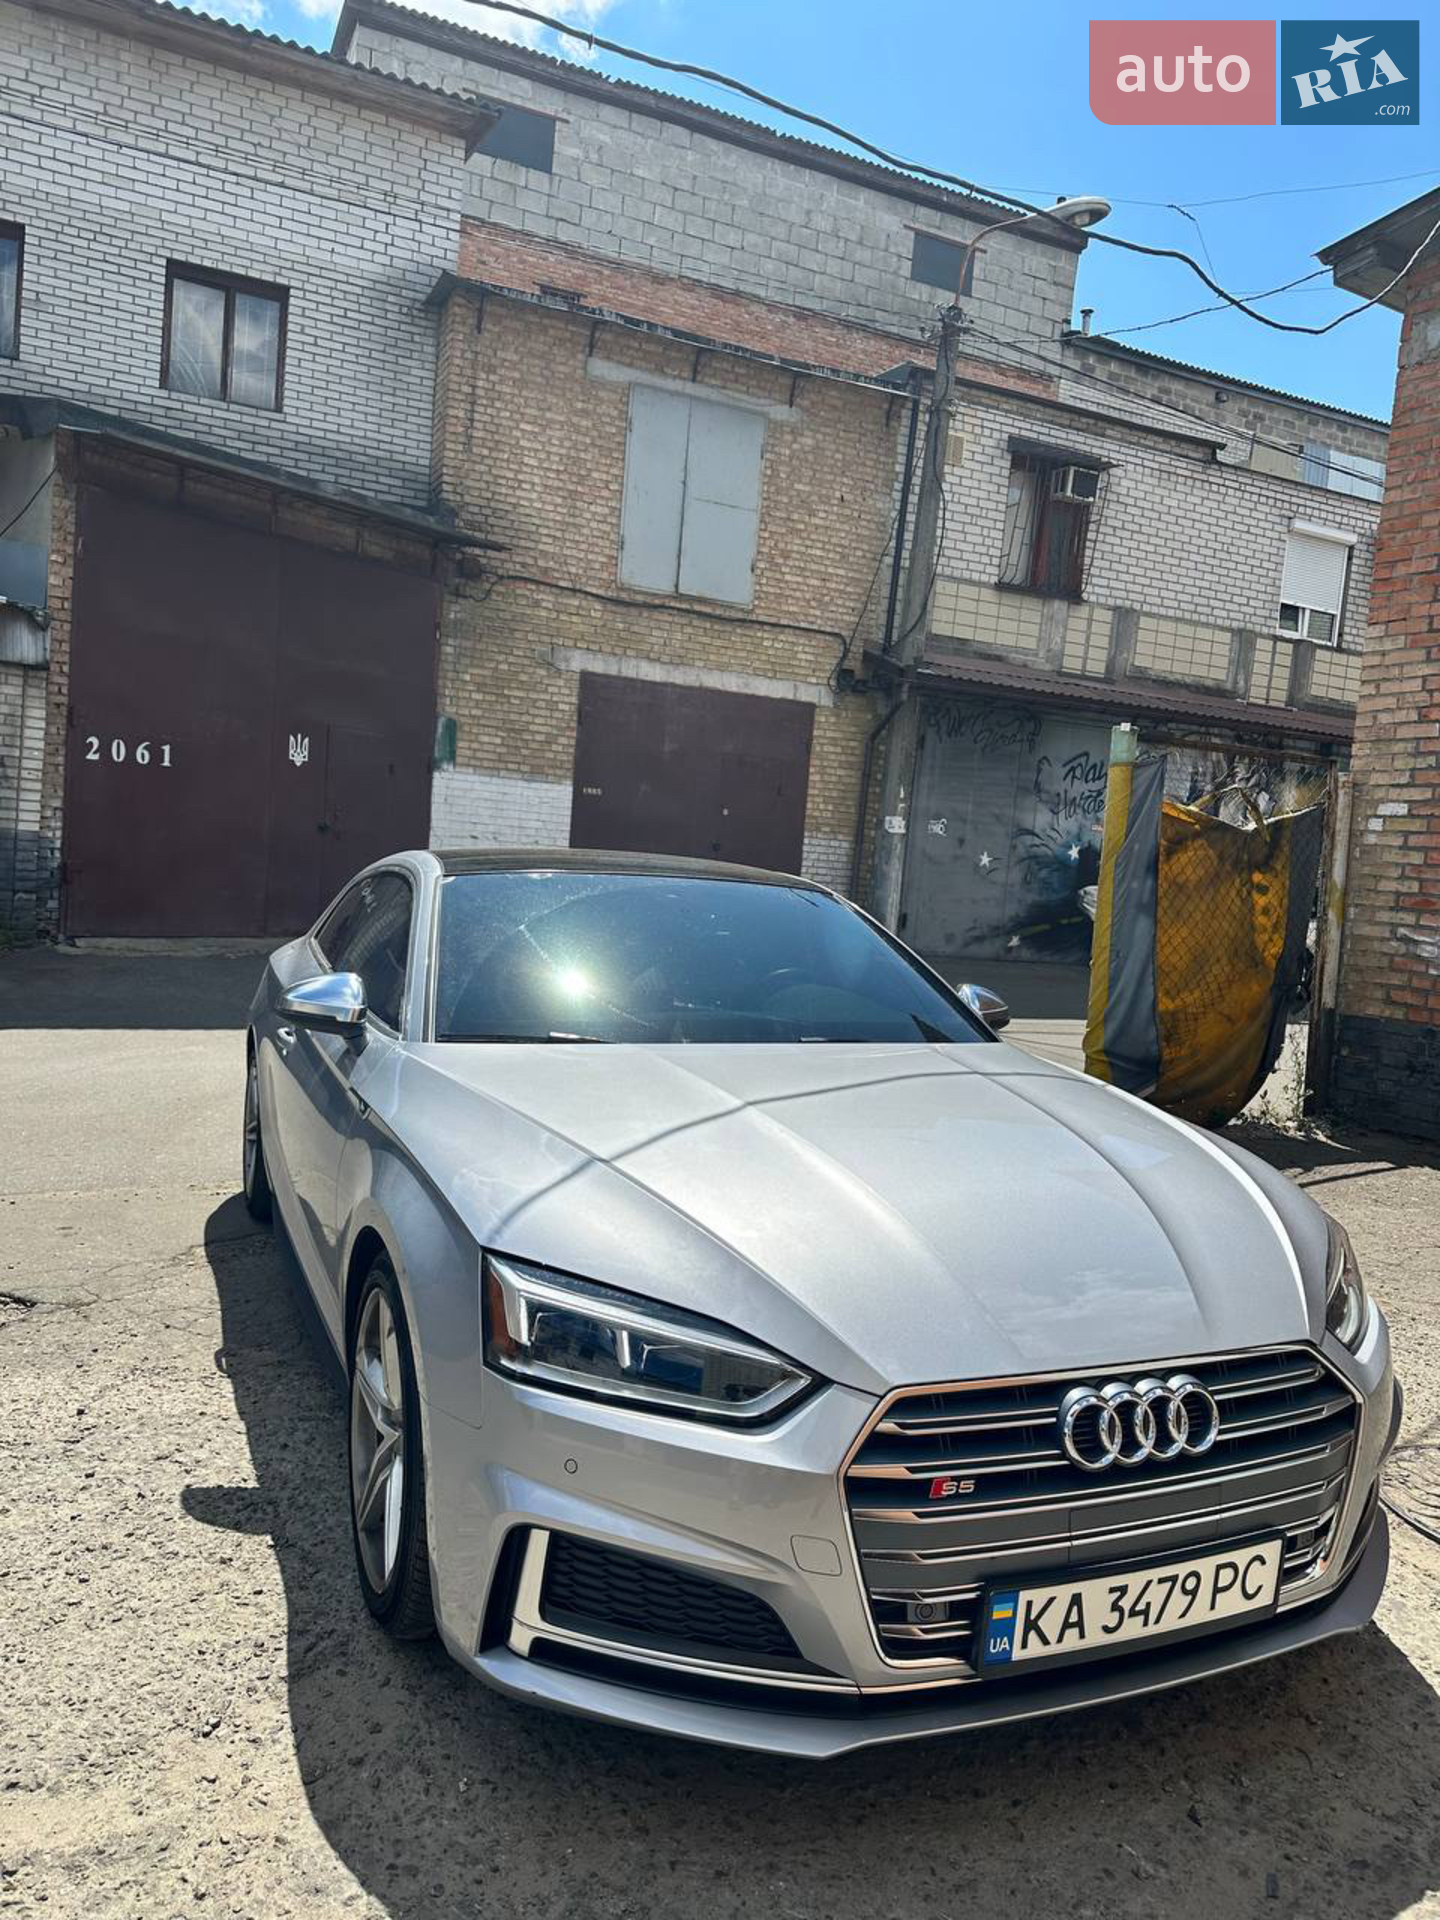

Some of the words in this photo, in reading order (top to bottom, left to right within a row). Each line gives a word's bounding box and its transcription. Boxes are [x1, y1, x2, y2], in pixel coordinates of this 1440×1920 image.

[85, 736, 172, 767] 2061
[941, 1480, 975, 1495] S5
[1021, 1592, 1086, 1650] KA
[1101, 1570, 1202, 1634] 3479
[1210, 1554, 1267, 1611] PC
[989, 1636, 1010, 1653] UA
